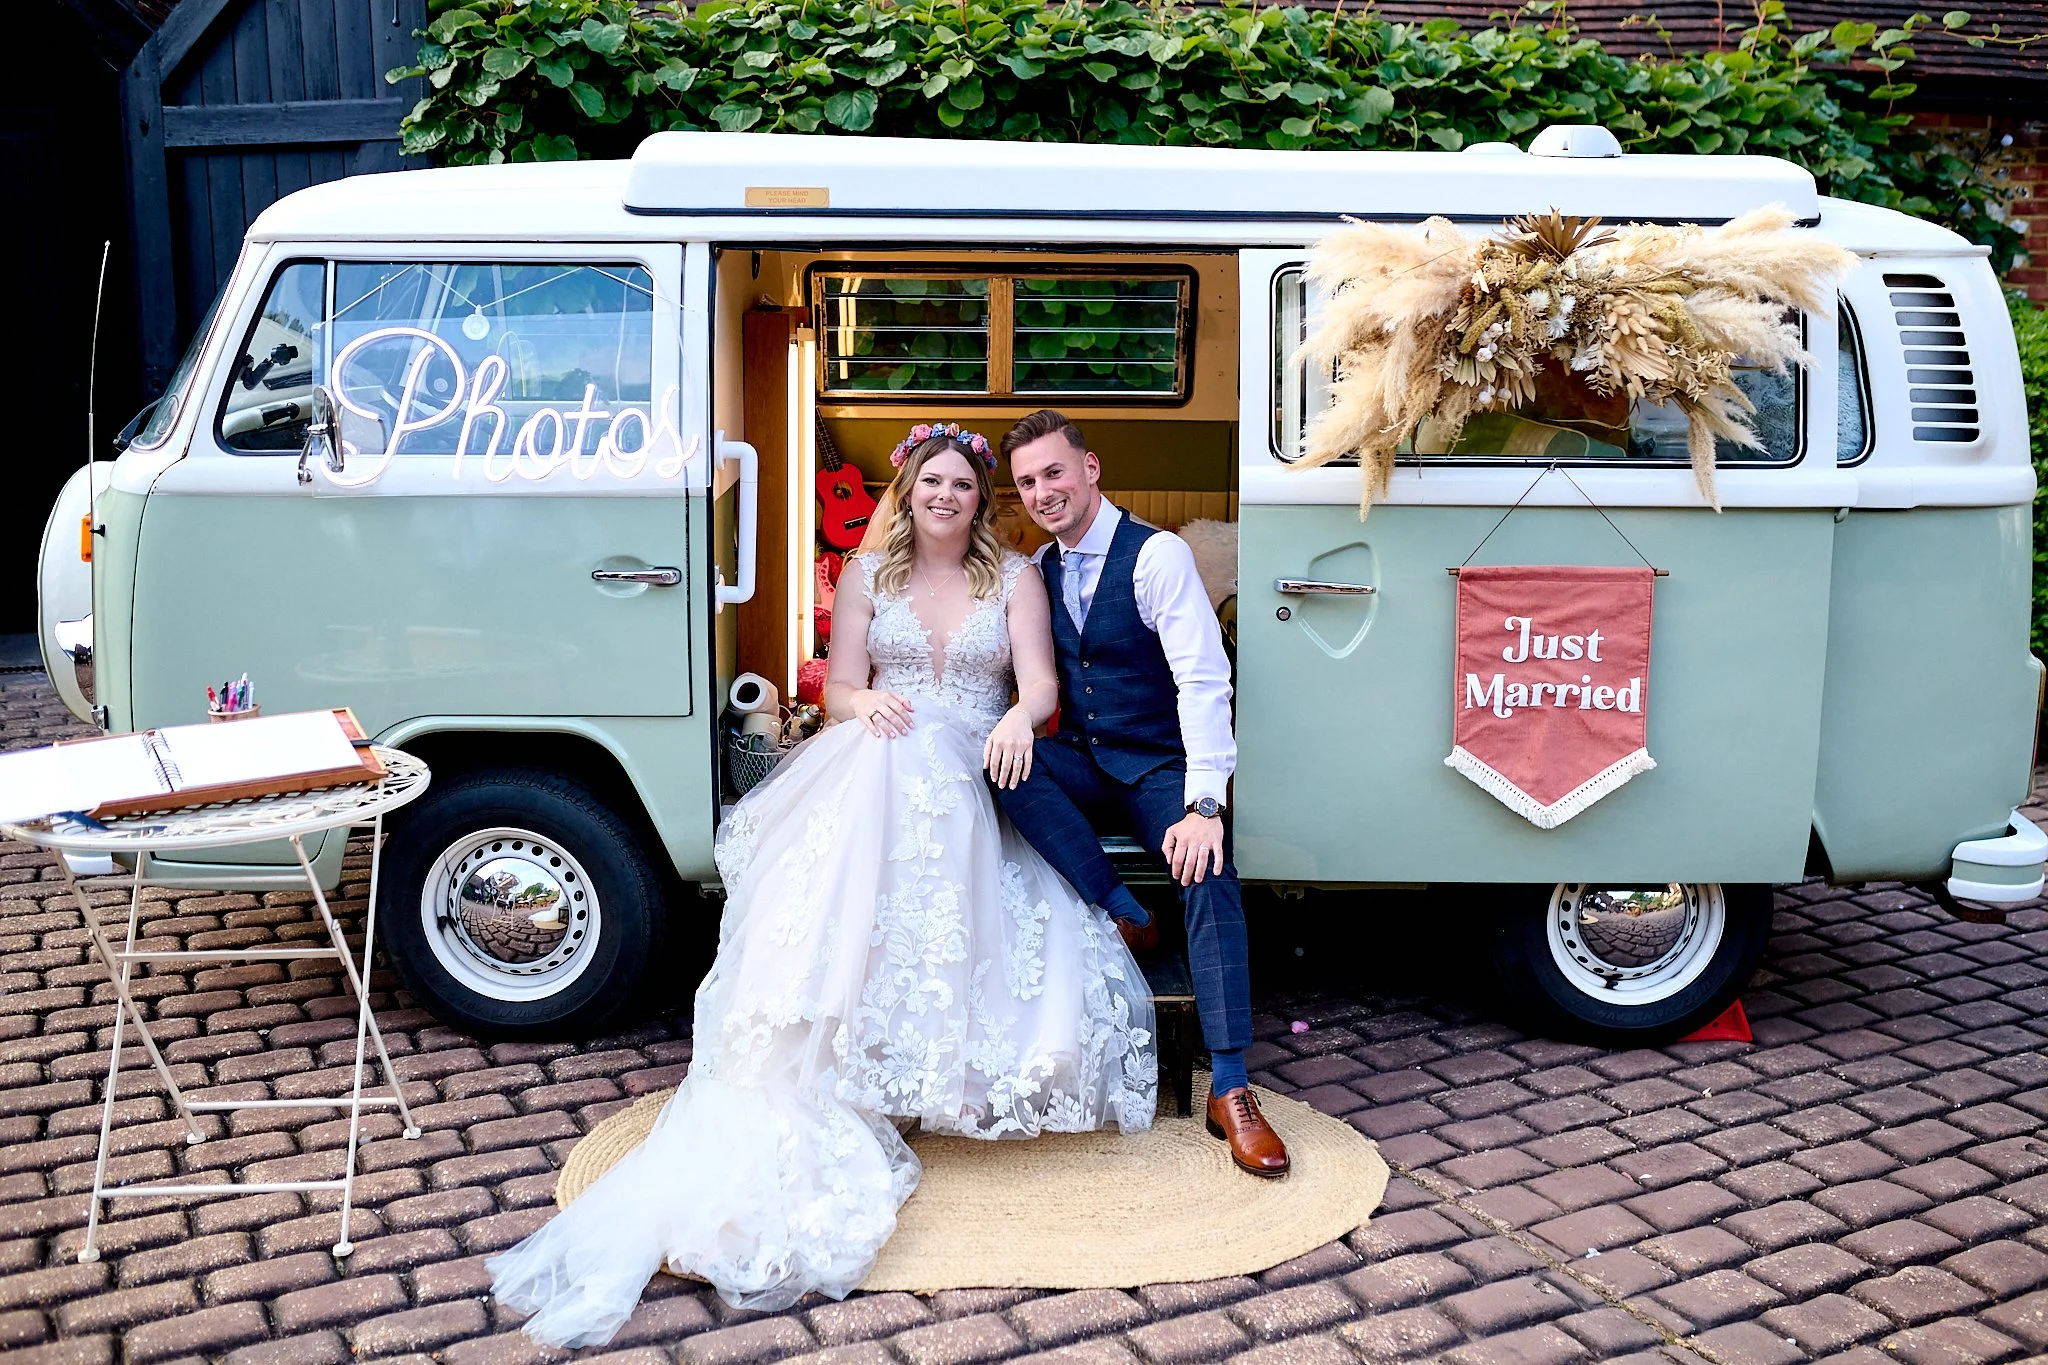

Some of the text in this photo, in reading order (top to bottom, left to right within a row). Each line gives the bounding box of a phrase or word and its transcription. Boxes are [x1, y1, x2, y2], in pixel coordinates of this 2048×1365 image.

[319, 326, 700, 487] Photos
[1502, 615, 1605, 663] Just
[1464, 673, 1642, 719] Married
